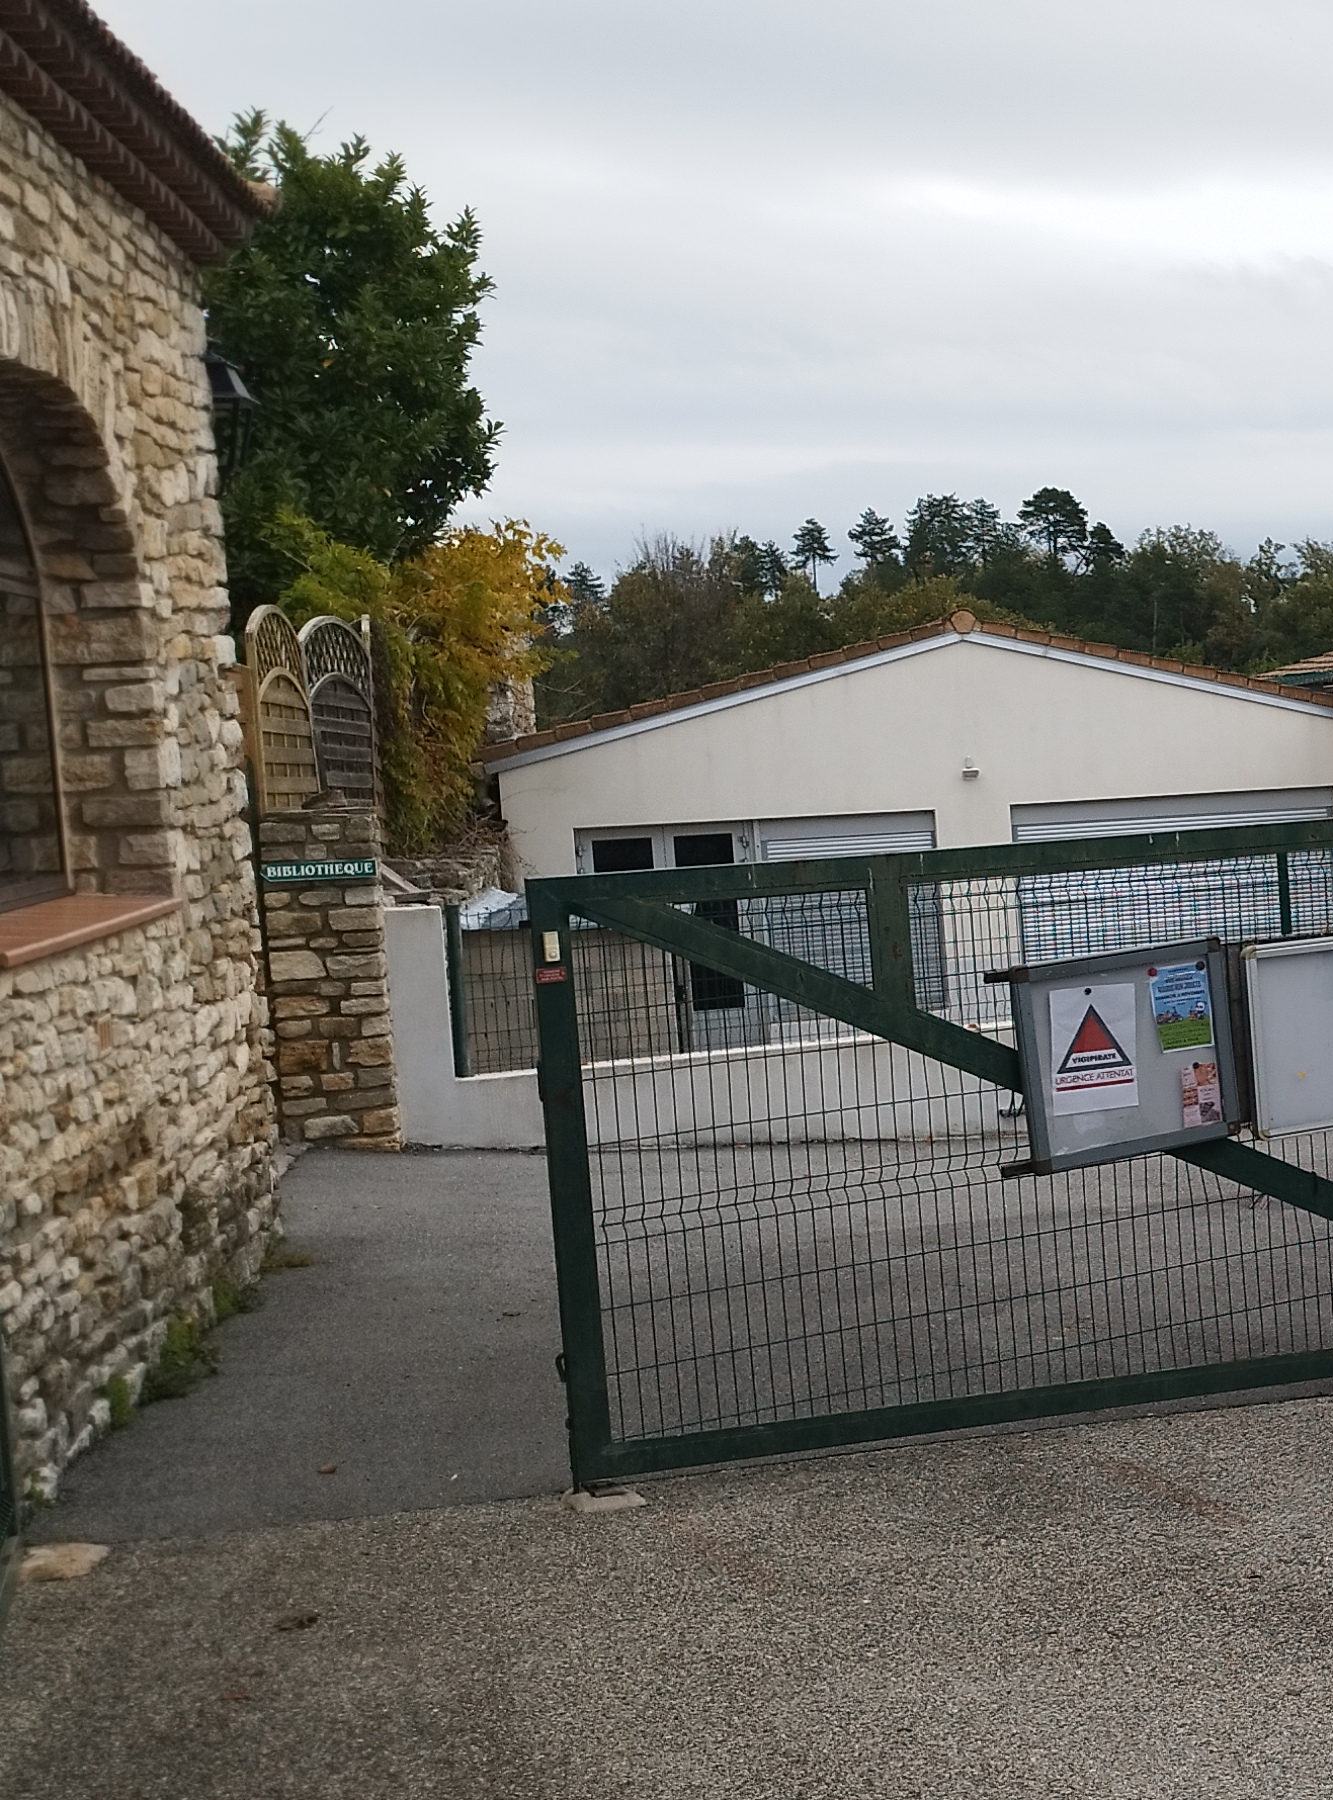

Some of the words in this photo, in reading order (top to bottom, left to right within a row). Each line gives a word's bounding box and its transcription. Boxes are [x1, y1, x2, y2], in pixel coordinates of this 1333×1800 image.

[266, 862, 374, 878] BIBLIOTHEQUE
[1071, 1053, 1117, 1064] VIGIPIRATE
[1055, 1073, 1095, 1085] URGENCE
[1096, 1069, 1133, 1080] ATTENTAT
